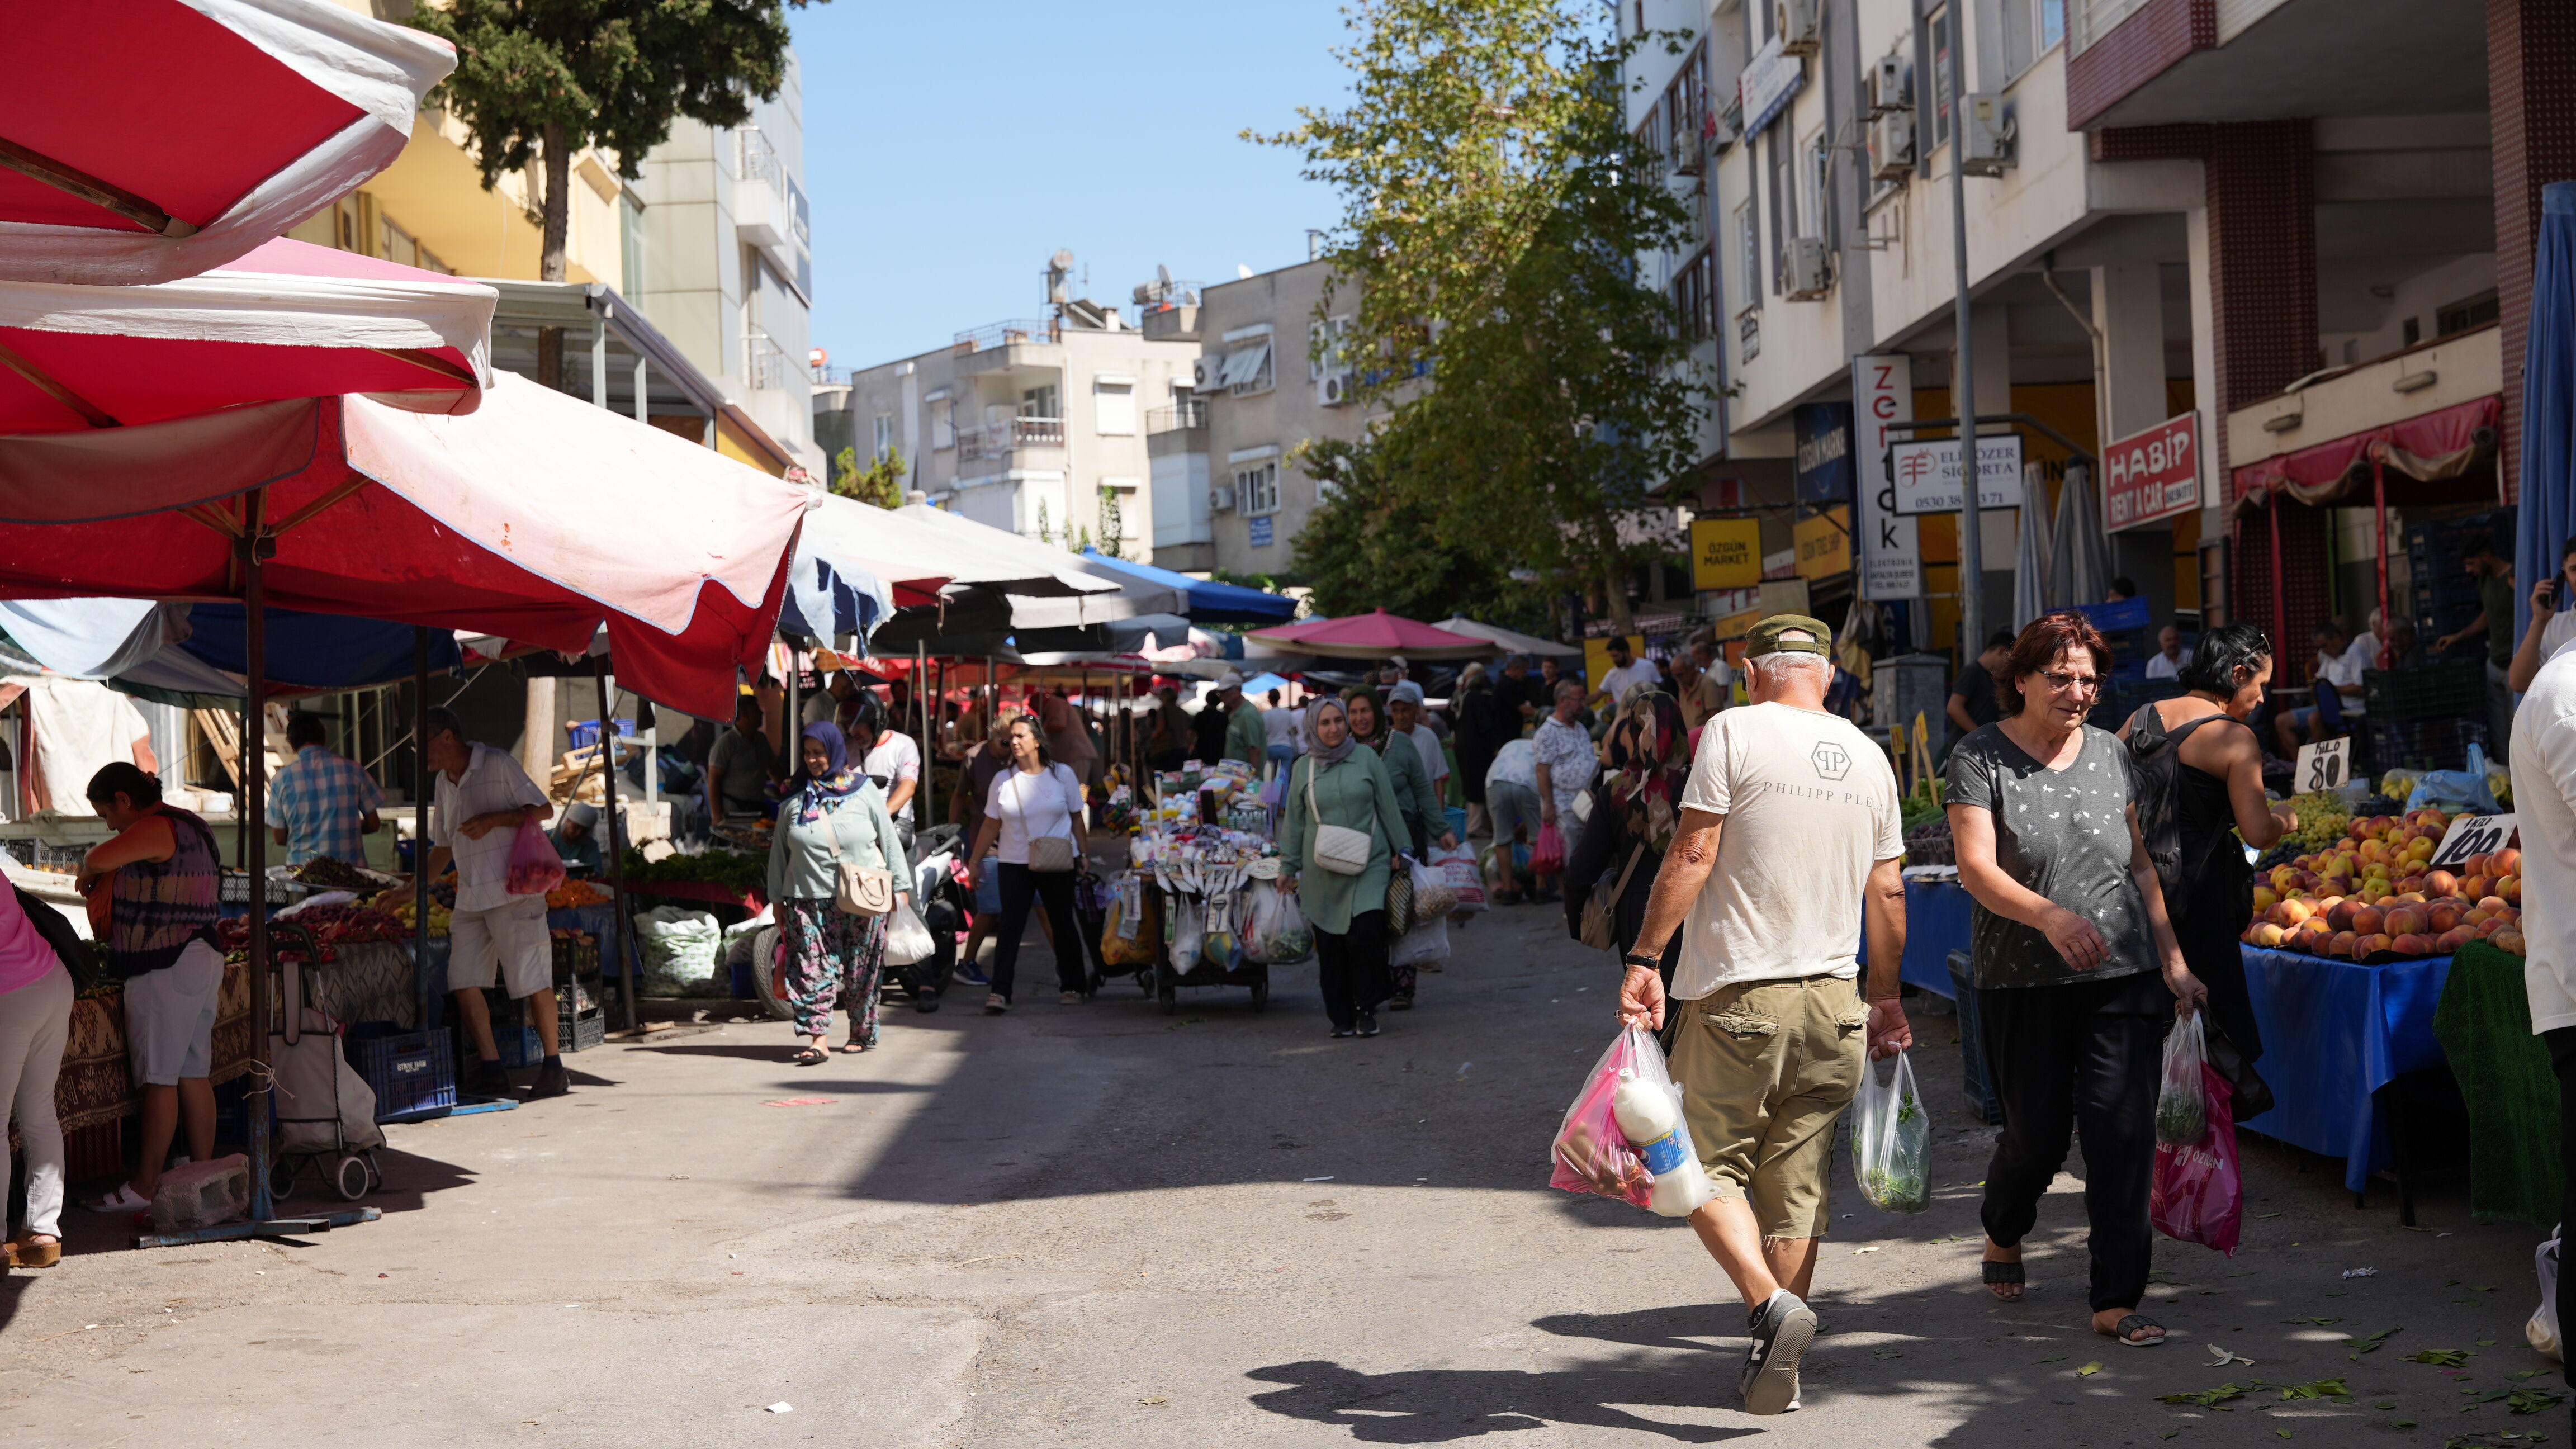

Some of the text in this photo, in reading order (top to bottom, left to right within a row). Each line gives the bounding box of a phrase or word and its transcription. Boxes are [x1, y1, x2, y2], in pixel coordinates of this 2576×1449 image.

[1940, 450, 1962, 463] ELİ
[2109, 427, 2190, 489] HABİP
[1708, 539, 1746, 554] ÖZGÜN
[1704, 553, 1750, 566] MARKET
[2308, 754, 2340, 790] 80
[1764, 782, 1834, 801] PHILIPP
[2432, 827, 2502, 866] 100
[2192, 1147, 2224, 1170] ÖZKAN
